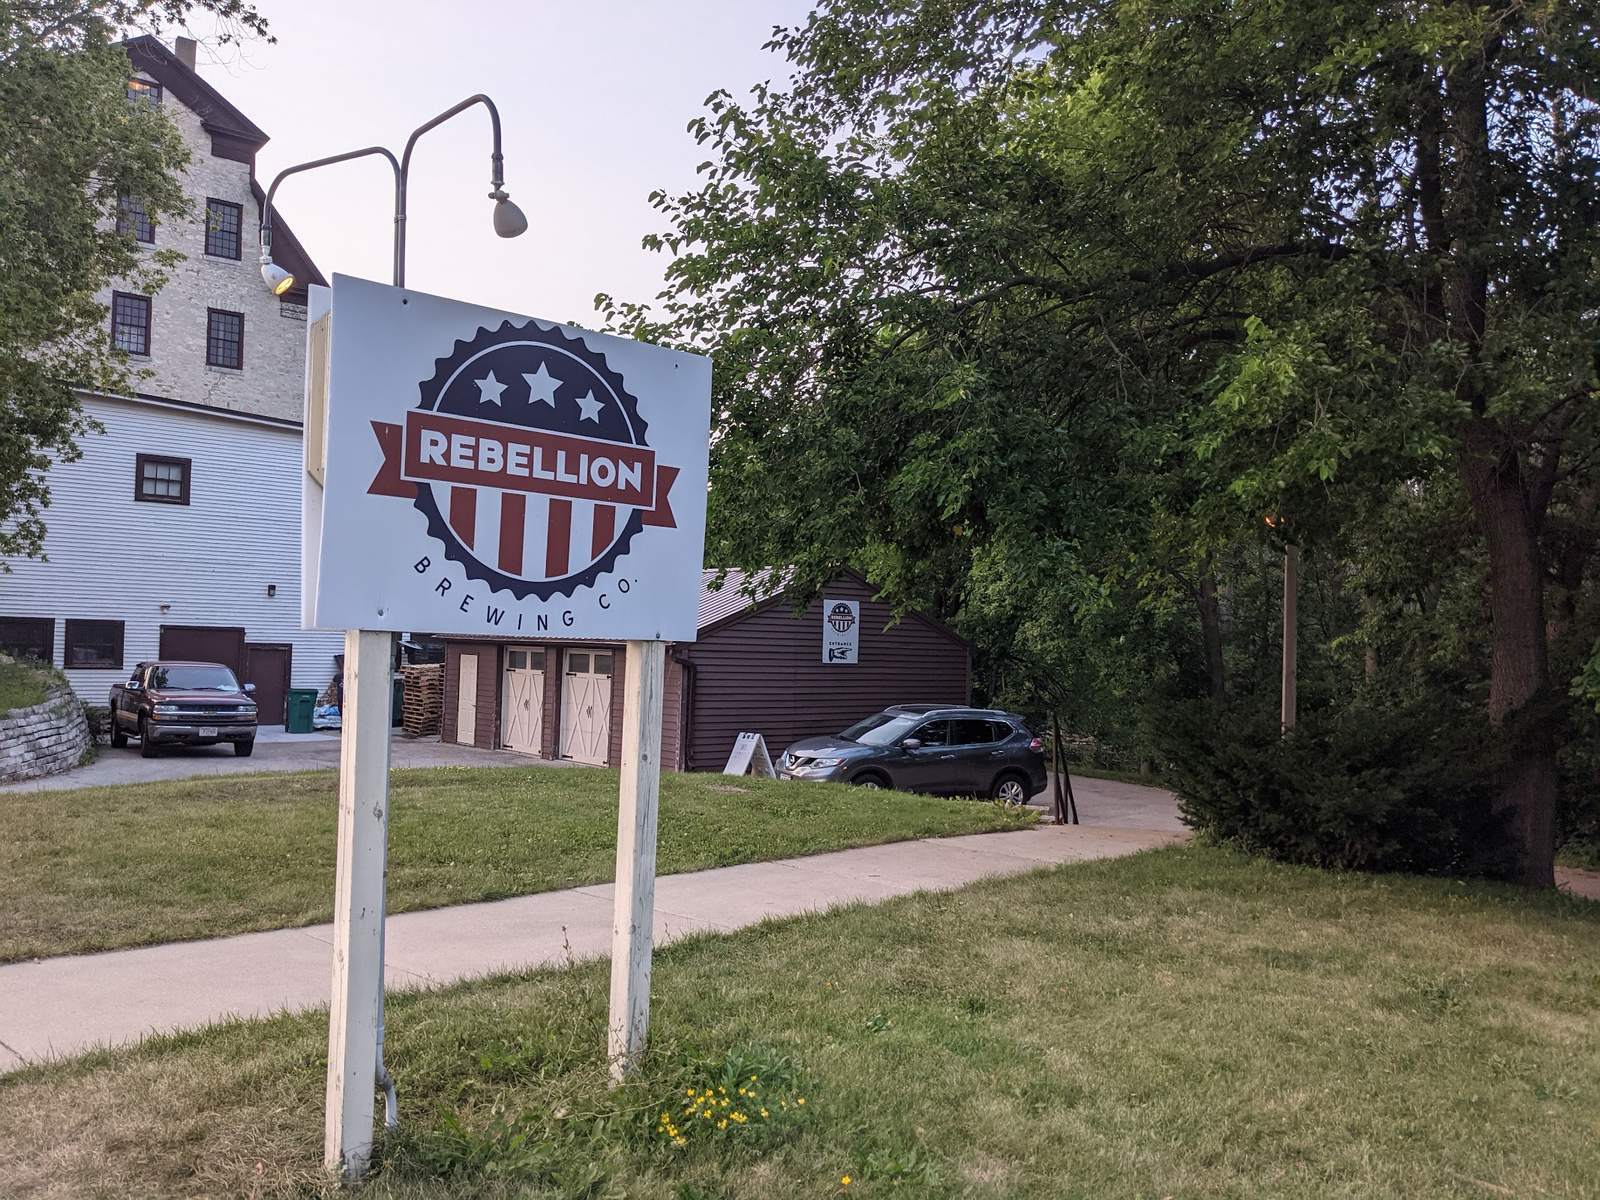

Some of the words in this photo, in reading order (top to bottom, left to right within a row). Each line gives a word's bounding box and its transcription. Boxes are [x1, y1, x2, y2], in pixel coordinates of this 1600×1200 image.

[420, 429, 642, 493] REBELLION
[413, 556, 574, 632] BREWING
[598, 577, 638, 610] CO.
